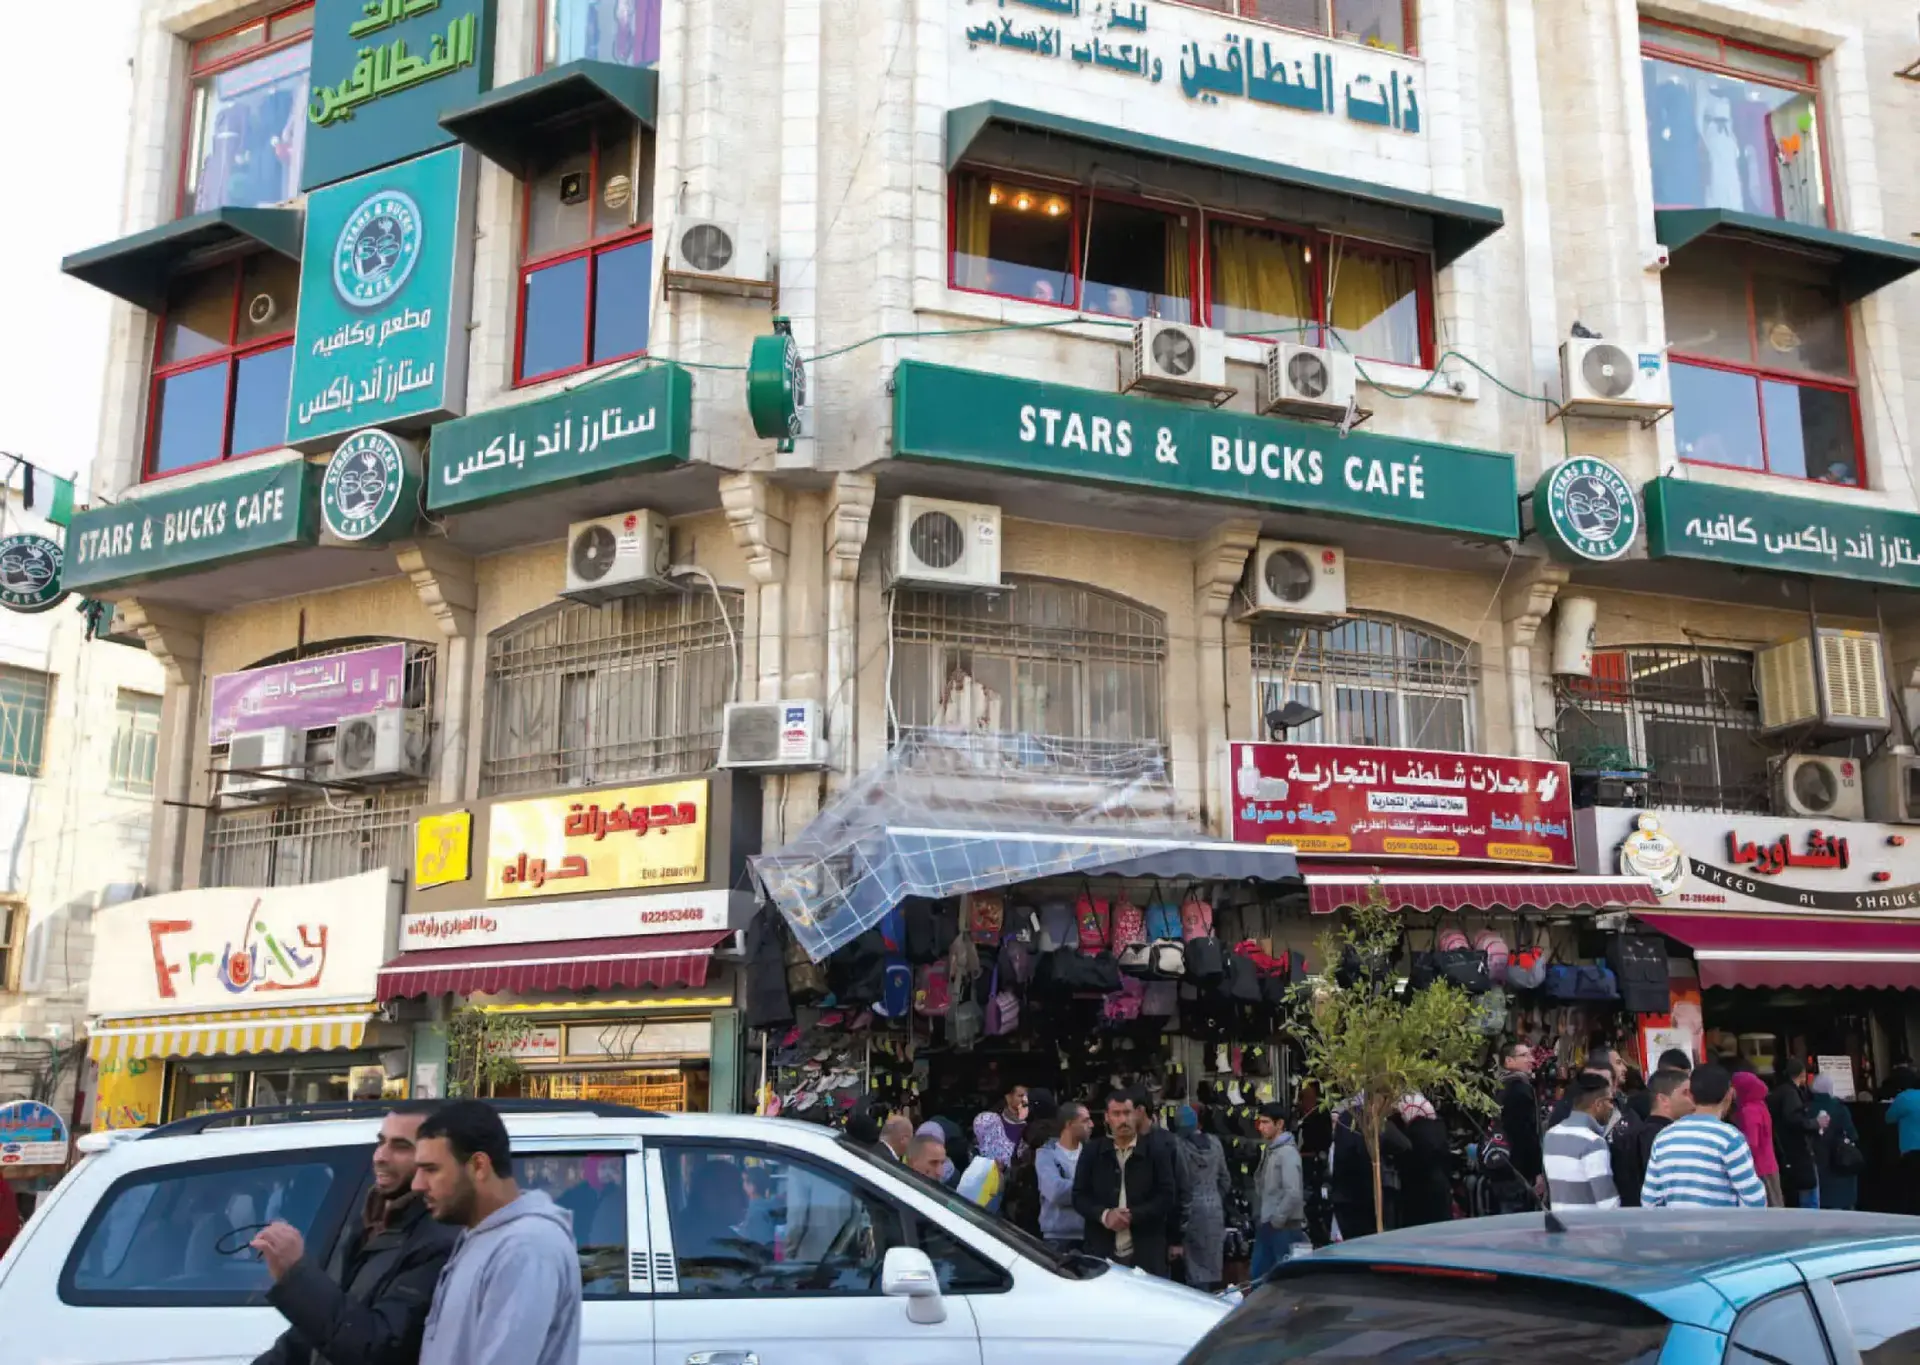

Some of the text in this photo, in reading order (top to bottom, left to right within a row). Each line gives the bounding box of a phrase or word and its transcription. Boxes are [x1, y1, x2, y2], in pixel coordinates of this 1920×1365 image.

[308, 12, 475, 126] النطاقين
[1071, 36, 1163, 83] والكتاب
[1179, 32, 1420, 133] ذات النطاقين
[312, 308, 431, 356] مطعم وكافيه
[299, 374, 354, 425] باكس
[384, 358, 435, 404] ستارز
[578, 406, 656, 454] ستارز
[1019, 404, 1425, 500] STARS & BUCKS CAFÉ
[443, 432, 526, 486] باكس
[1552, 462, 1630, 506] STARS & BUCKS
[77, 521, 134, 565] STARS
[139, 514, 153, 550] &
[163, 501, 226, 546] BUCKS
[1685, 512, 1758, 546] كافيه
[1763, 525, 1838, 561] باكس
[1285, 753, 1387, 792] التجارية
[1470, 764, 1530, 794] محلات
[563, 801, 697, 841] مجوهرات
[1800, 893, 1816, 906] AL
